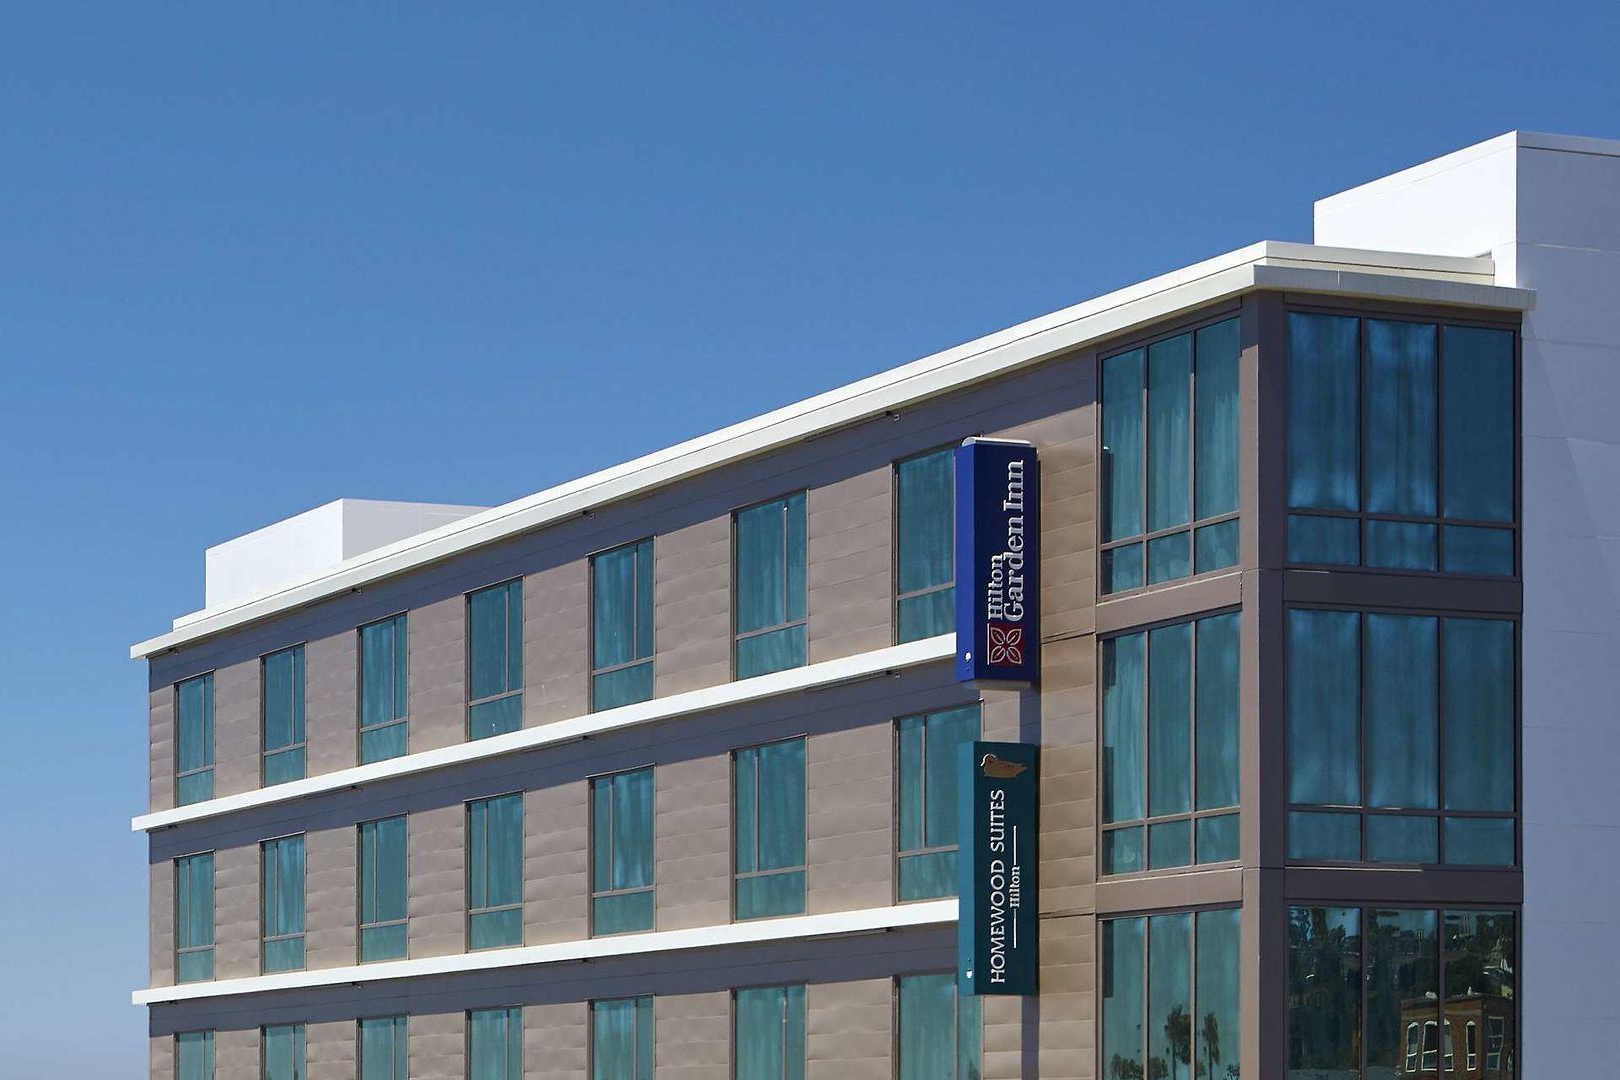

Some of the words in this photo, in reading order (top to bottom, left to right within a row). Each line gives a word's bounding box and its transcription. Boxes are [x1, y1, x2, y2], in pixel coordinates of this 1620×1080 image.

[1003, 459, 1024, 512] Inn
[987, 554, 1004, 621] Hilton
[1003, 515, 1024, 622] Garden
[990, 789, 1005, 853] SUITES
[1009, 865, 1020, 908] Hilton
[990, 858, 1005, 984] HOMEWOOD
